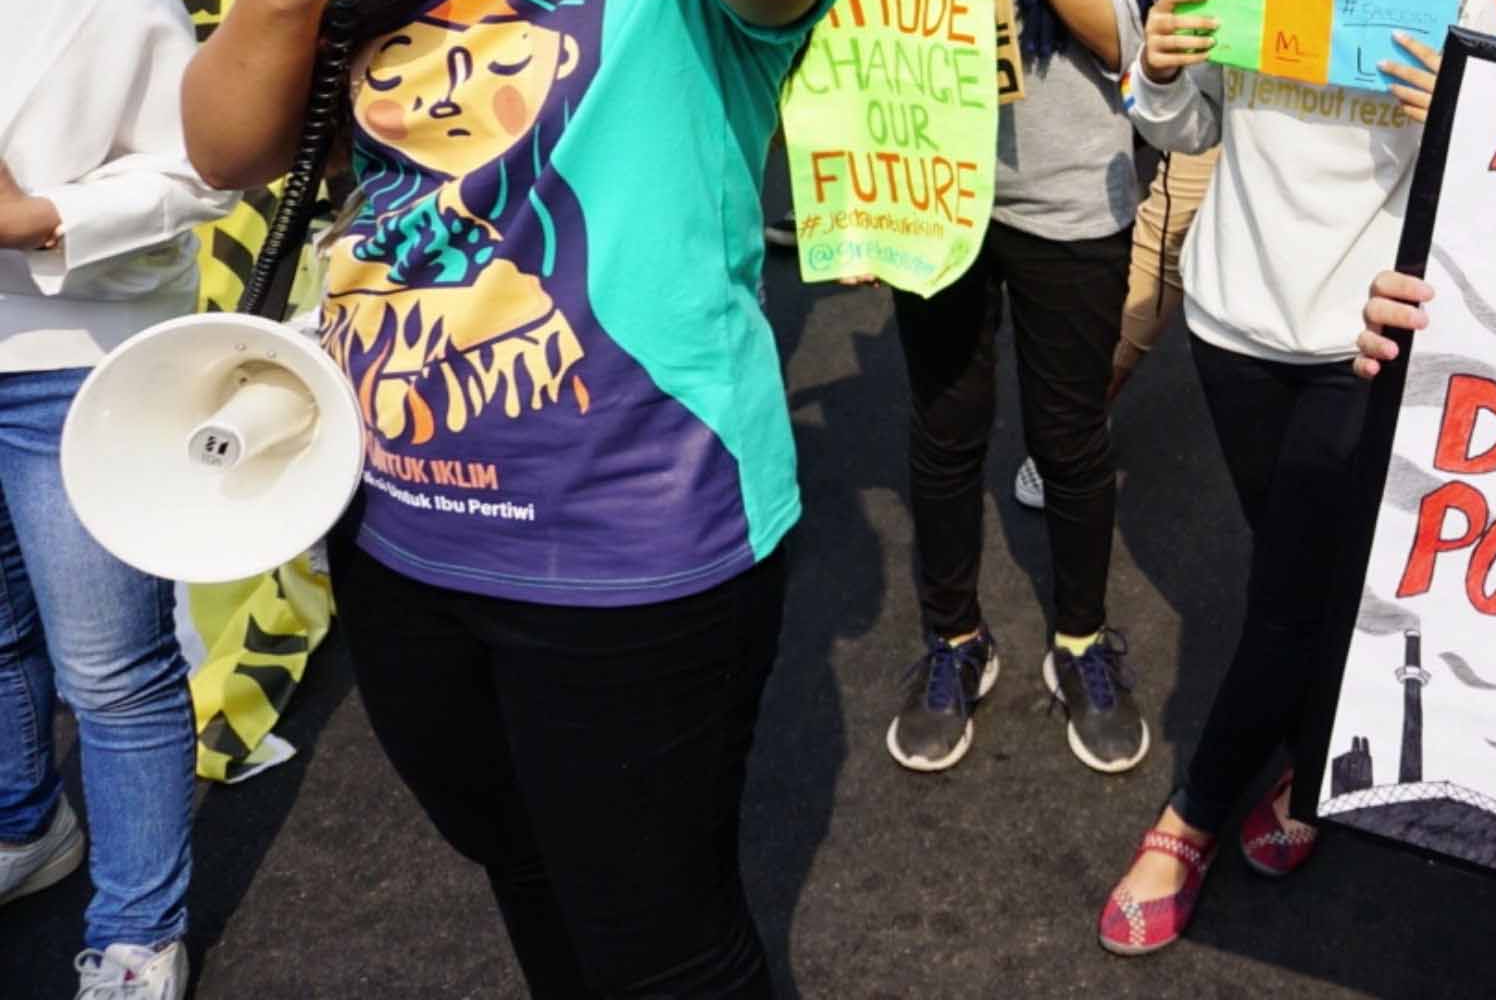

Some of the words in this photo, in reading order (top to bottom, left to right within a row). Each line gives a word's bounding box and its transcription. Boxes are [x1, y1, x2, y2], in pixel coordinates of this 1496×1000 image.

[800, 37, 986, 109] CHANGE
[867, 101, 938, 153] OUR
[812, 151, 977, 228] FUTURE
[430, 460, 498, 490] IKLIM
[434, 496, 465, 514] Ibu
[469, 499, 535, 521] Pertiwi
